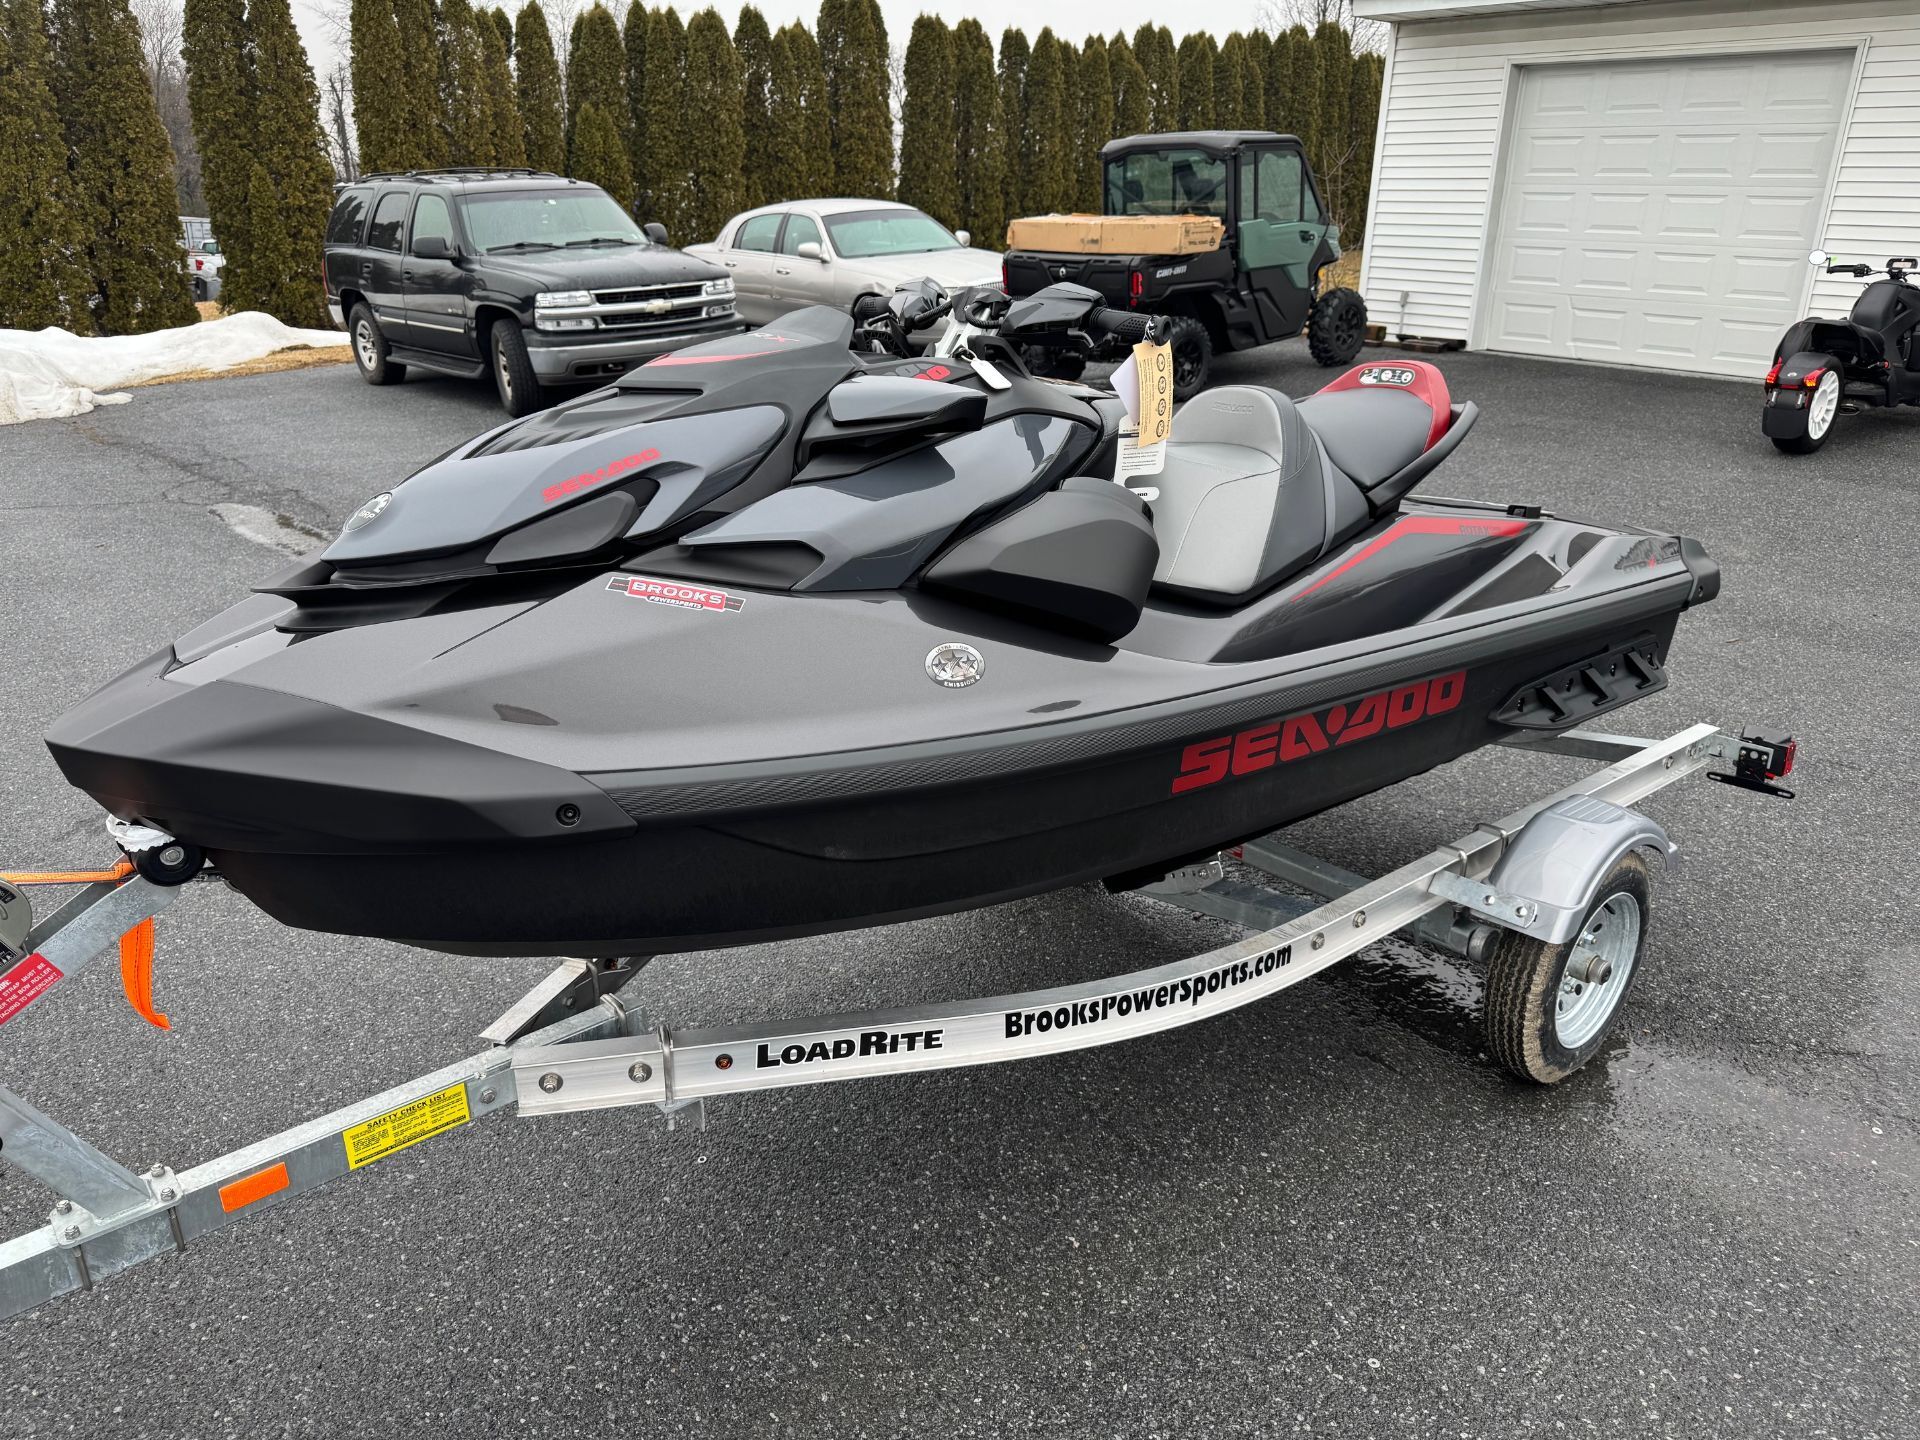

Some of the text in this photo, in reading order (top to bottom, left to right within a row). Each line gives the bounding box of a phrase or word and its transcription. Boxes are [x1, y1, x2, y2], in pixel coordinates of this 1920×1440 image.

[631, 581, 722, 604] BROOKS
[649, 595, 702, 609] POWERSPORTS
[943, 677, 975, 688] EMISSION
[21, 969, 36, 983] MUST
[37, 962, 47, 970] BE
[6, 993, 19, 1003] THE
[17, 983, 31, 995] BOW
[31, 967, 53, 985] ROLLER
[26, 972, 58, 998] WATERCRAFT
[1005, 944, 1292, 1038] BrooksPowerSports.com
[366, 1112, 399, 1130] SAFETY
[400, 1100, 428, 1116] CHECK
[429, 1092, 448, 1103] LIST
